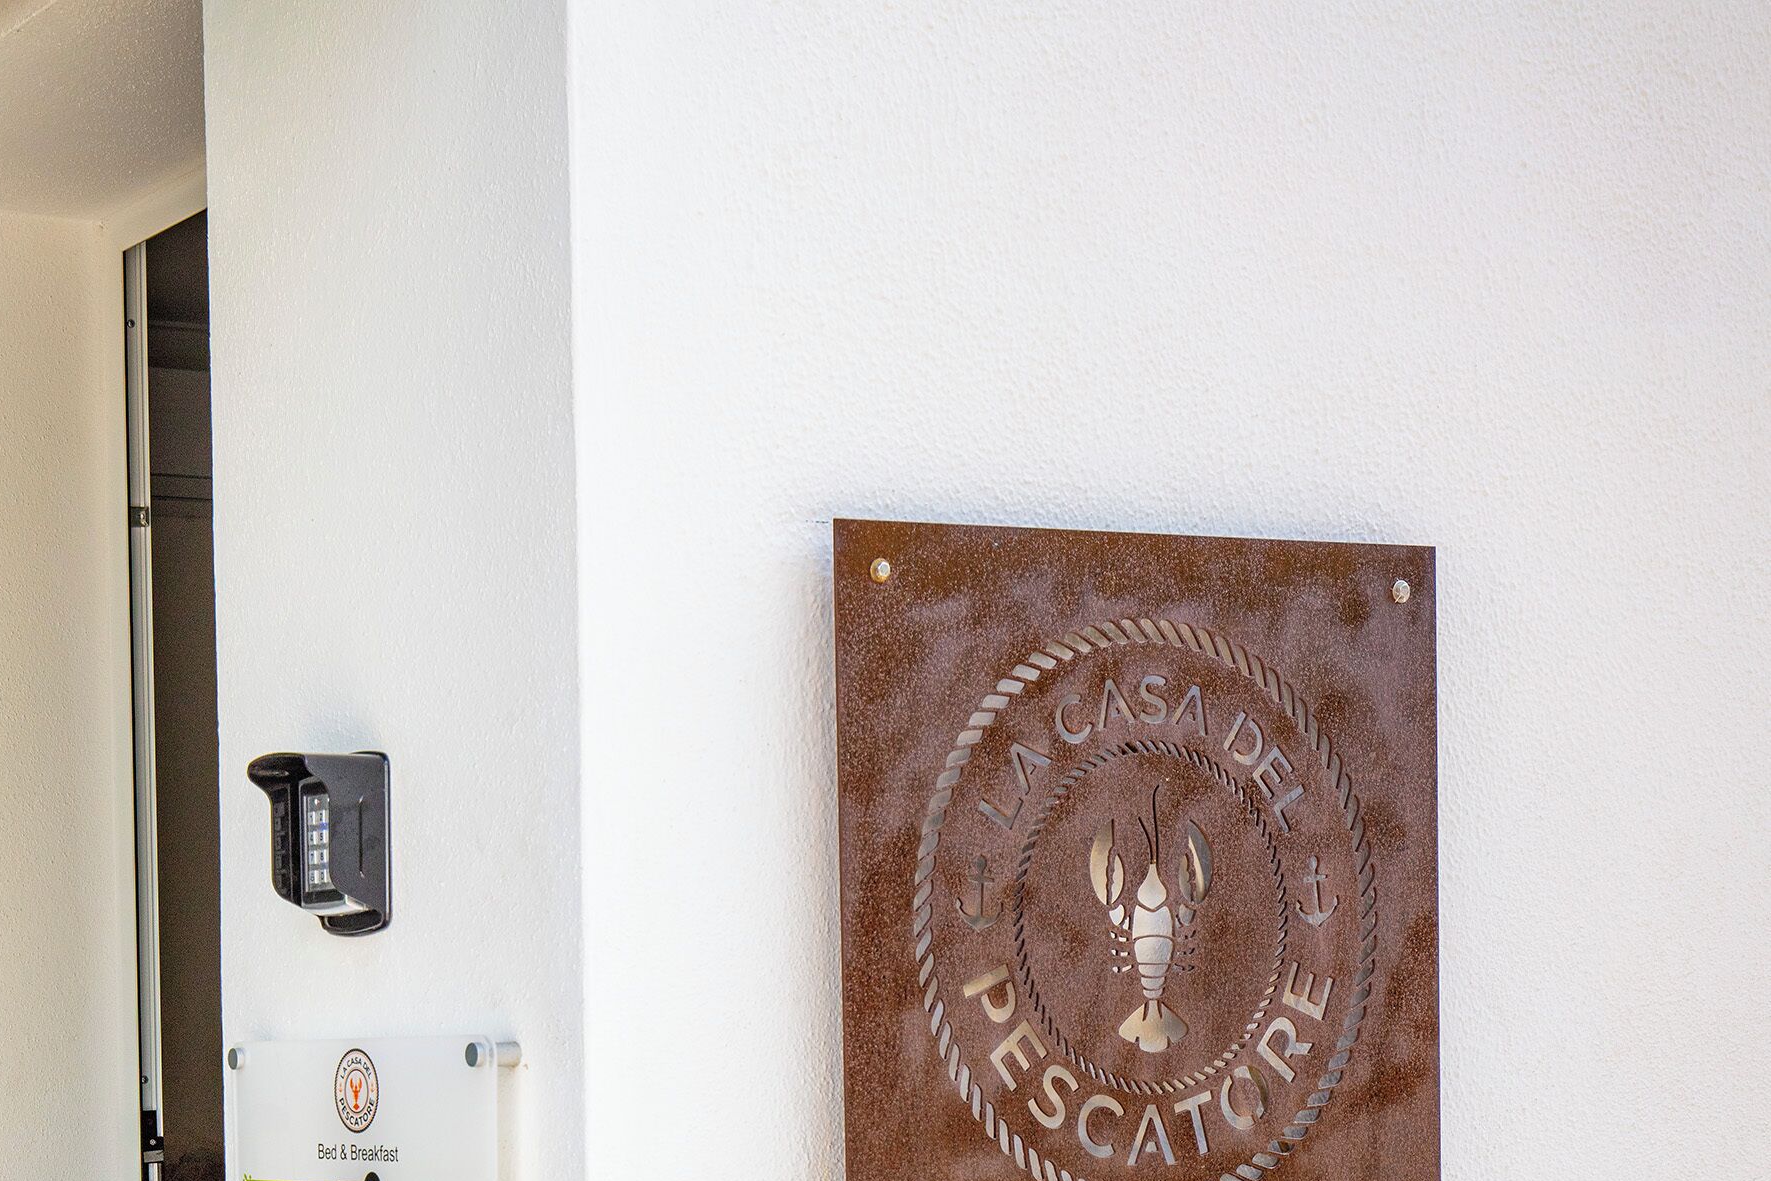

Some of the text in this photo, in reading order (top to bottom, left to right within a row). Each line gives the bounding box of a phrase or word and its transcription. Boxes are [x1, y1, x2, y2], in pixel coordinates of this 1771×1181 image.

[979, 674, 1305, 835] LA CASA DEL
[340, 1057, 373, 1079] LA CASA DEL
[963, 961, 1335, 1166] PESCATORE
[339, 1098, 375, 1127] PESCATORE
[318, 1143, 398, 1162] Bed & Breakfast
